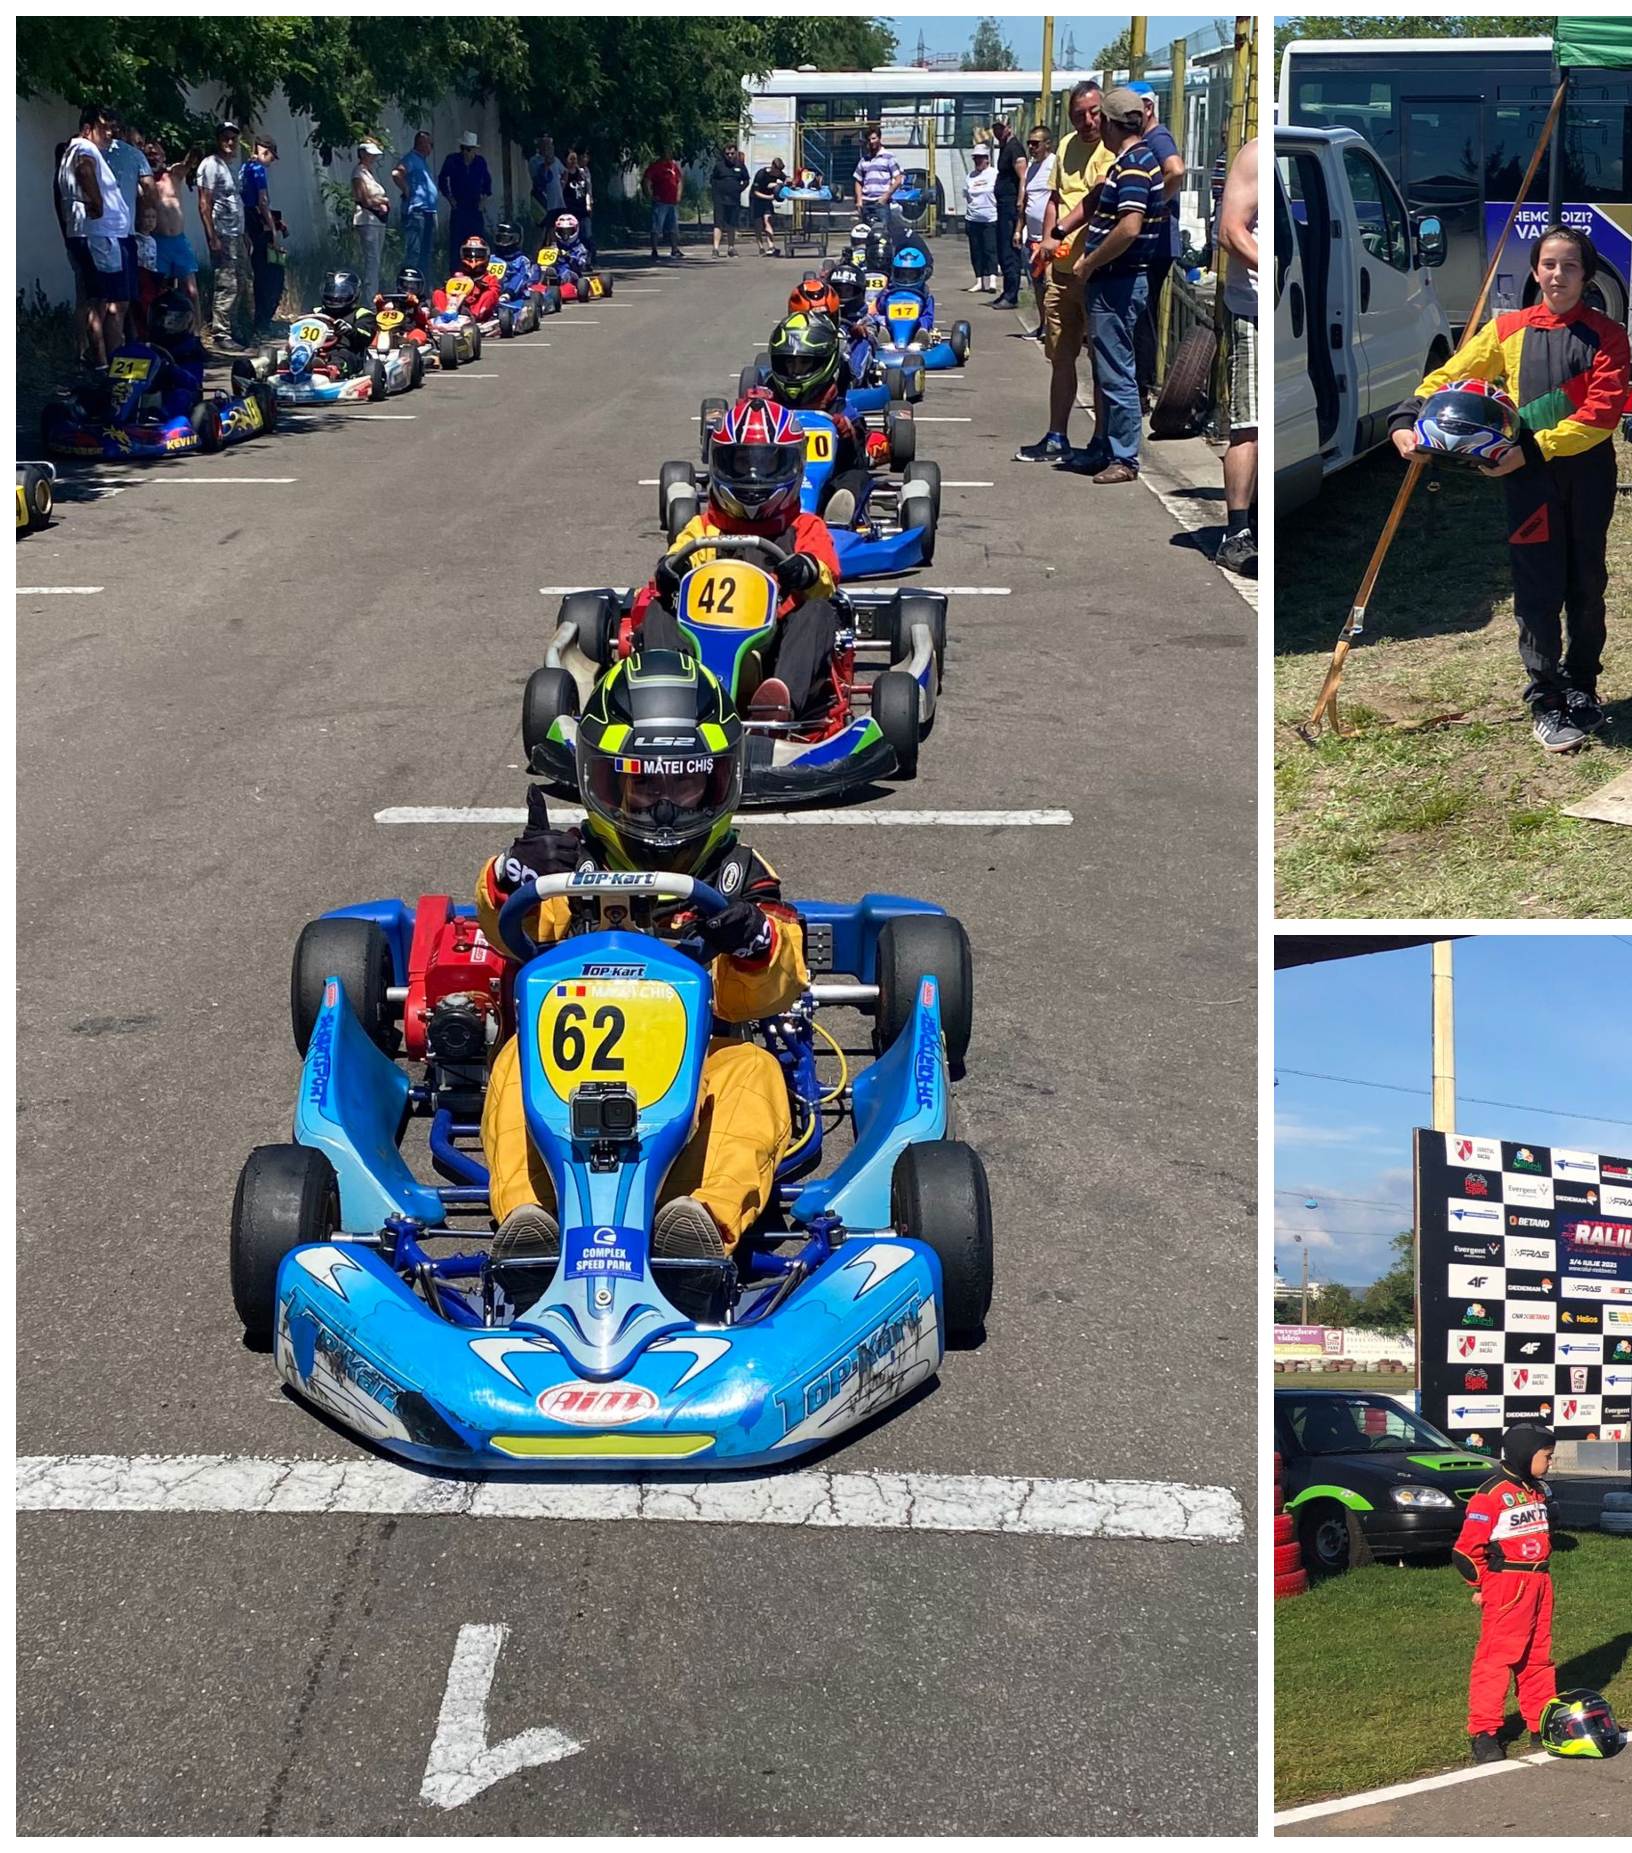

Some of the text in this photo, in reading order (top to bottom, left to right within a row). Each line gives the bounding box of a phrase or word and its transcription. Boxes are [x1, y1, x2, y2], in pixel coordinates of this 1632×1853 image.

[541, 250, 557, 262] 66
[490, 264, 505, 276] 68
[830, 271, 857, 282] ALEX
[894, 307, 913, 316] 17
[299, 326, 320, 342] 30
[114, 358, 134, 375] 21
[166, 435, 199, 450] KEVIN
[698, 576, 737, 614] 42
[633, 736, 696, 747] LS2
[643, 758, 684, 775] MATEI
[552, 1003, 626, 1072] 62
[1518, 1217, 1550, 1229] BETANO
[582, 1248, 627, 1259] COMPLEX
[1454, 1245, 1487, 1256] Evergent
[576, 1260, 632, 1271] SPEED PARK
[1467, 1276, 1488, 1288] 4F
[1520, 1342, 1541, 1355] 4F
[1604, 1407, 1630, 1416] Evergent
